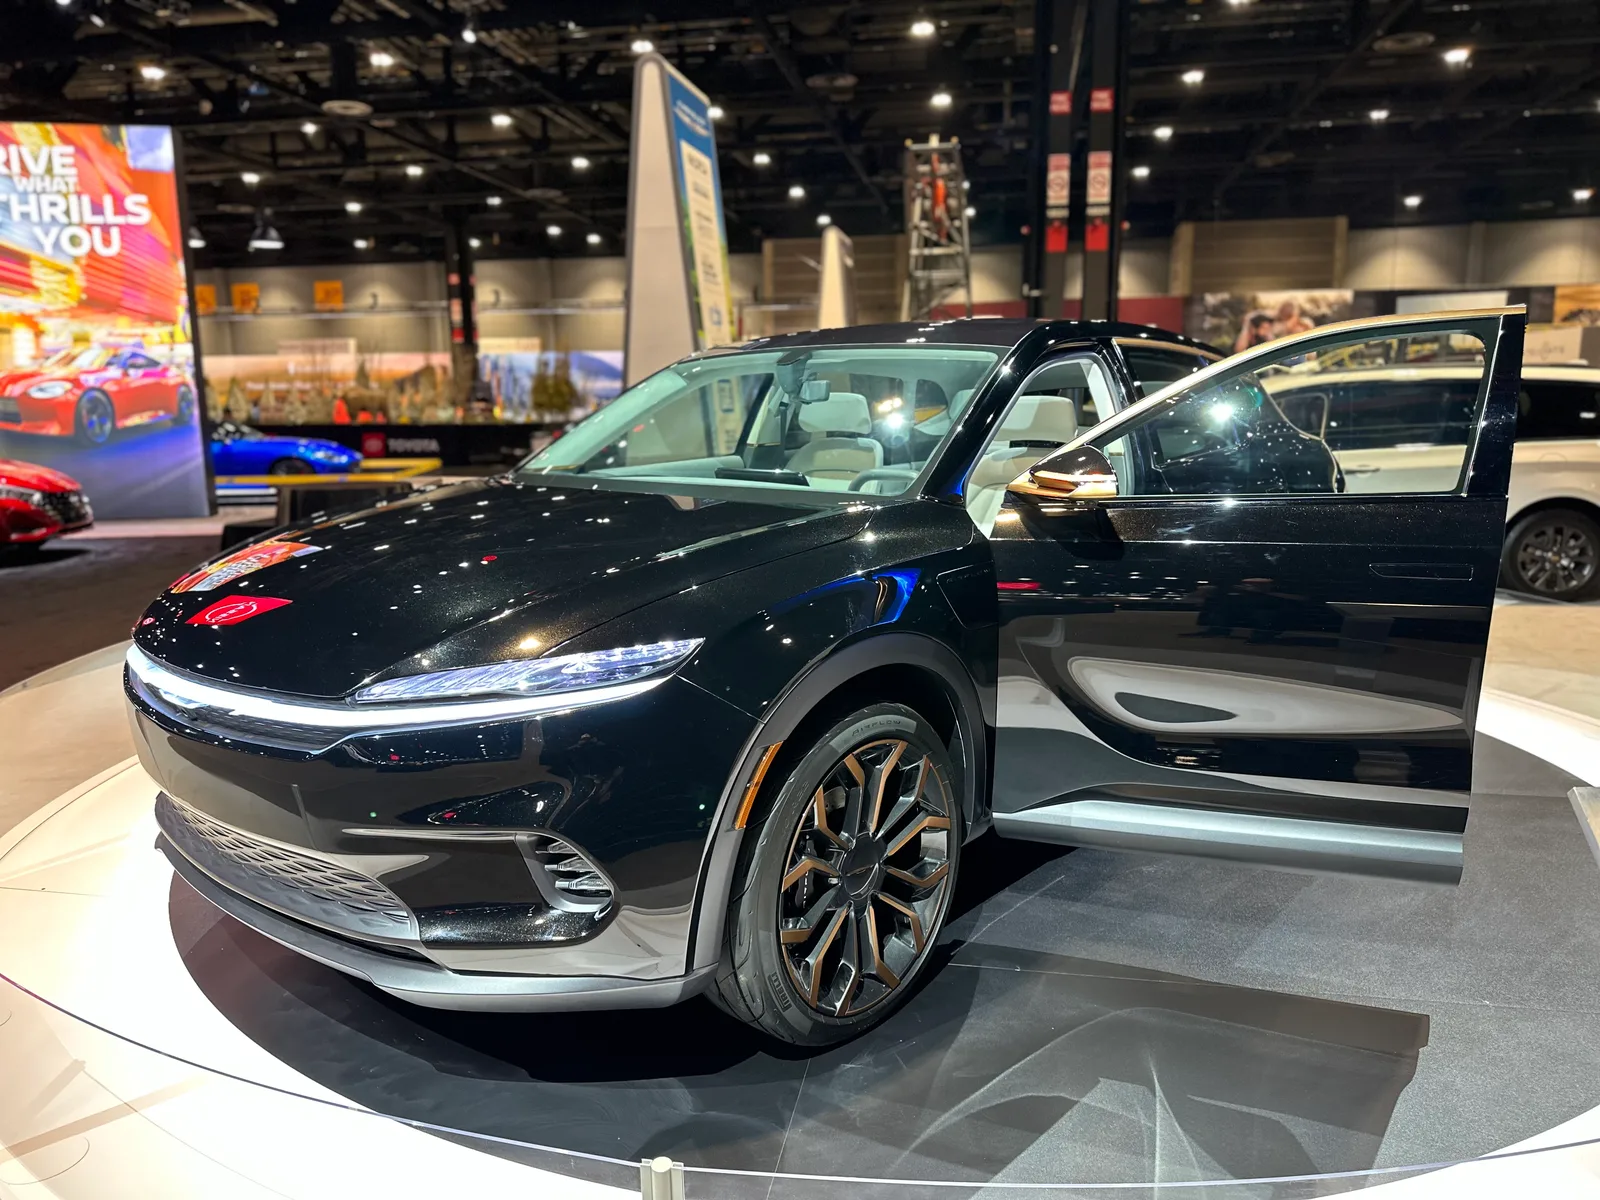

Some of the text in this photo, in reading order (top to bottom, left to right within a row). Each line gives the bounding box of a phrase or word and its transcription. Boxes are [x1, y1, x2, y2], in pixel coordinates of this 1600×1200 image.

[14, 175, 77, 192] WHAT
[34, 226, 120, 256] YOU
[387, 438, 440, 453] TOYOTA
